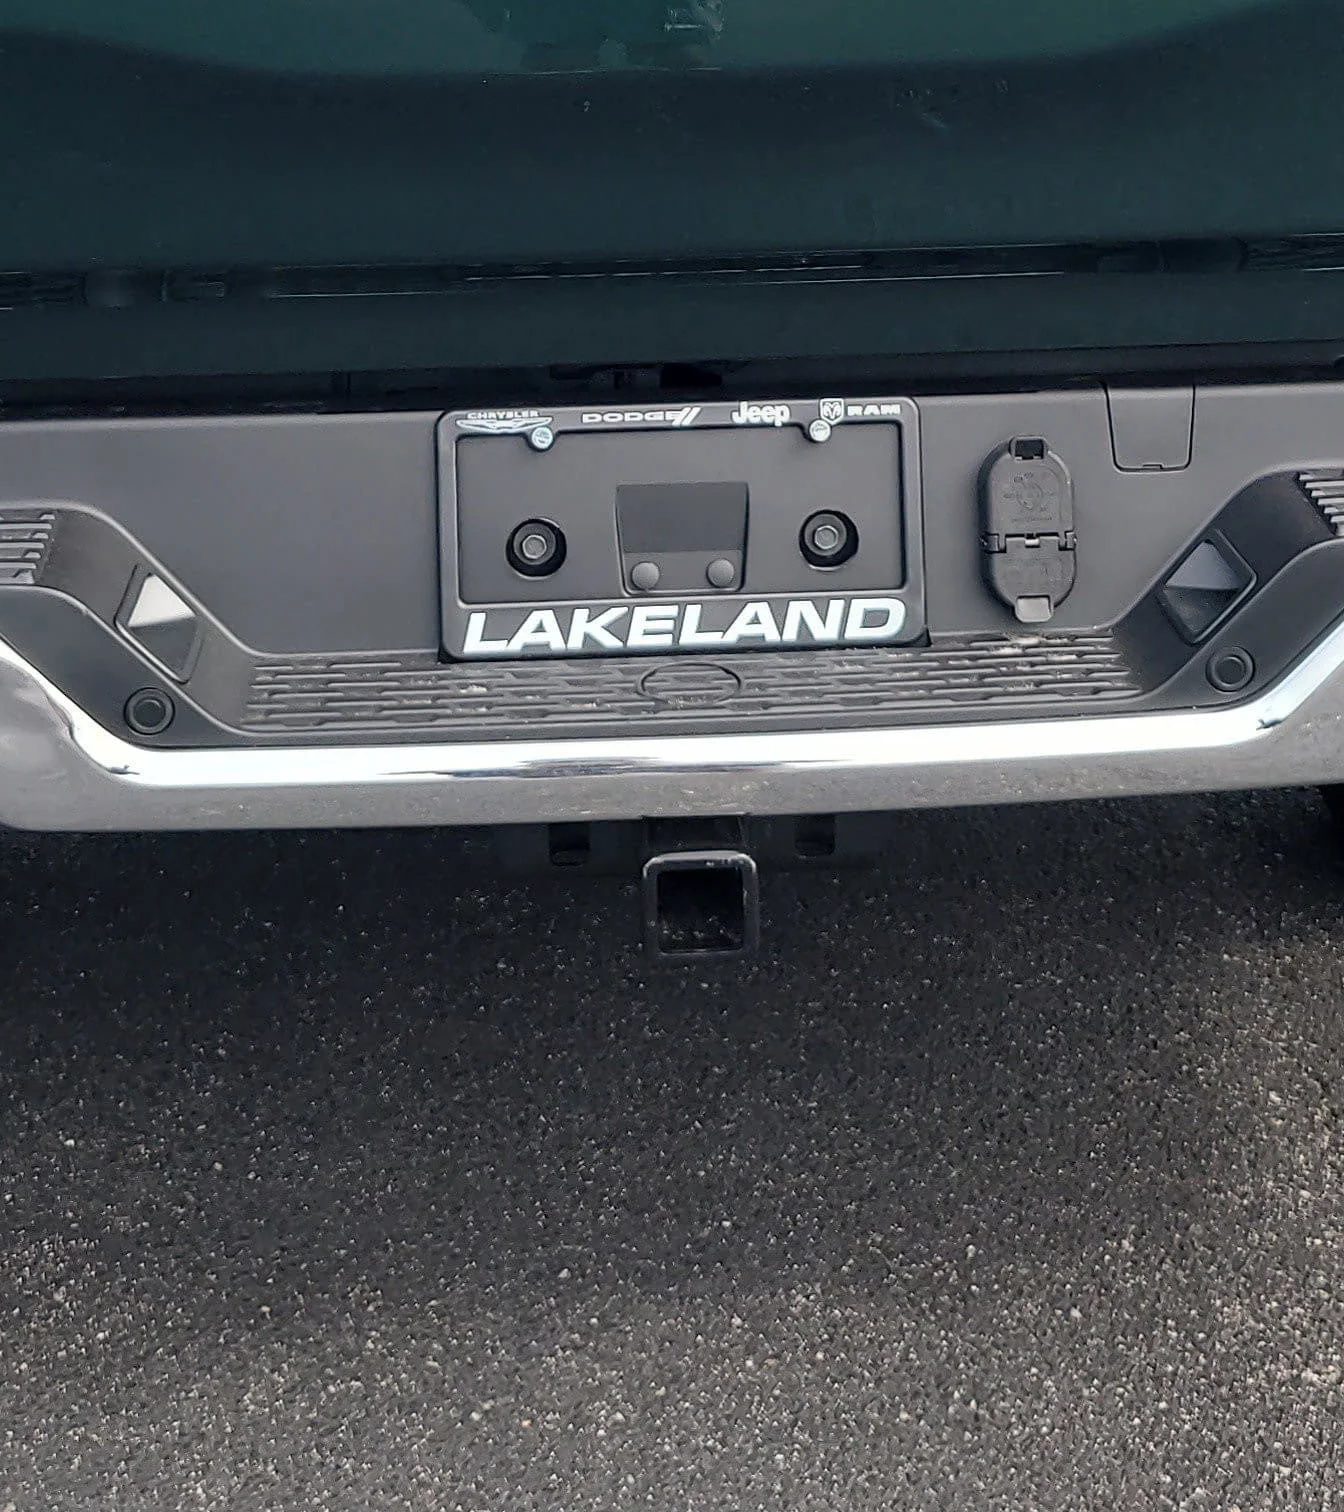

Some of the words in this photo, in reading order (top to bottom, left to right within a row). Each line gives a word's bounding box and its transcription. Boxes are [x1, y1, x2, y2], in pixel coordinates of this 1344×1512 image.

[466, 409, 540, 420] CHRYSLER
[582, 409, 686, 424] DODGE
[731, 400, 790, 427] Jeep
[847, 403, 901, 417] RAM
[462, 597, 907, 656] LAKELAND
